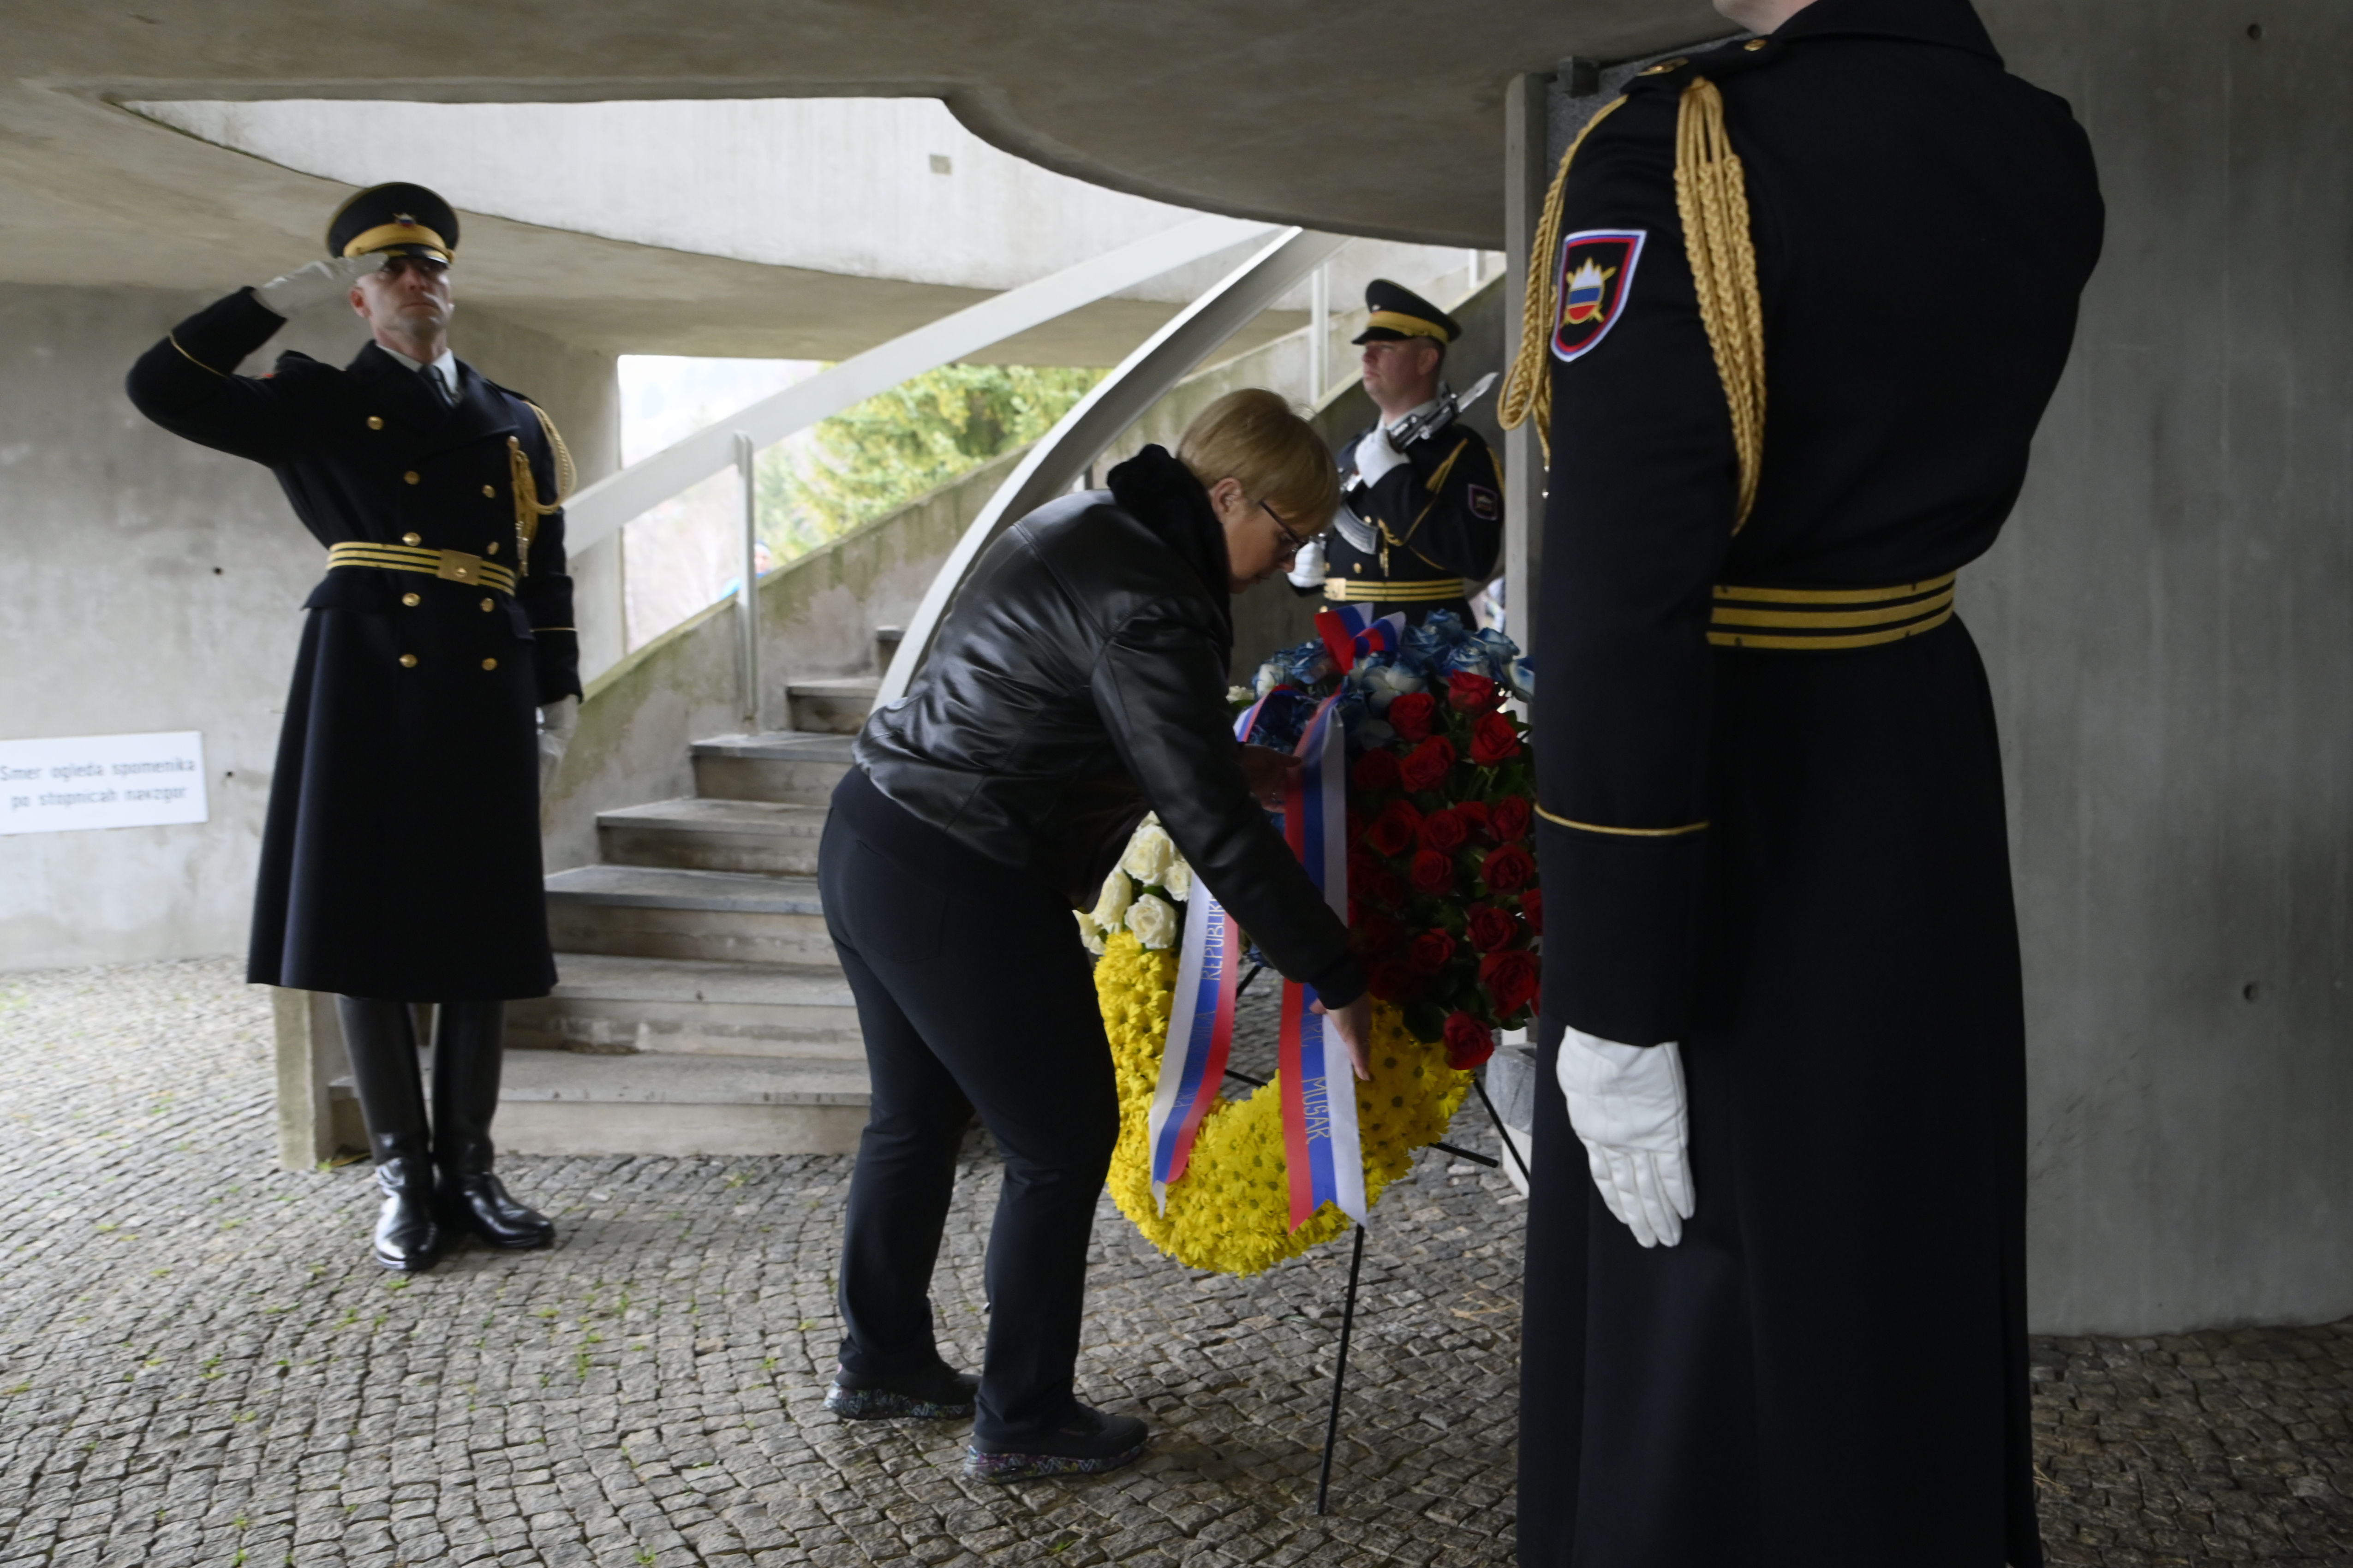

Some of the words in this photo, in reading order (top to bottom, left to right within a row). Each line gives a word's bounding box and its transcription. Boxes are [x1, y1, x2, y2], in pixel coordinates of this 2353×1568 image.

[0, 765, 42, 781] Smer
[50, 761, 104, 781] ogleda
[111, 758, 196, 778] spomenika
[11, 795, 30, 811] po
[38, 788, 117, 808] stopnicah
[1301, 1076, 1331, 1144] MUSAR
